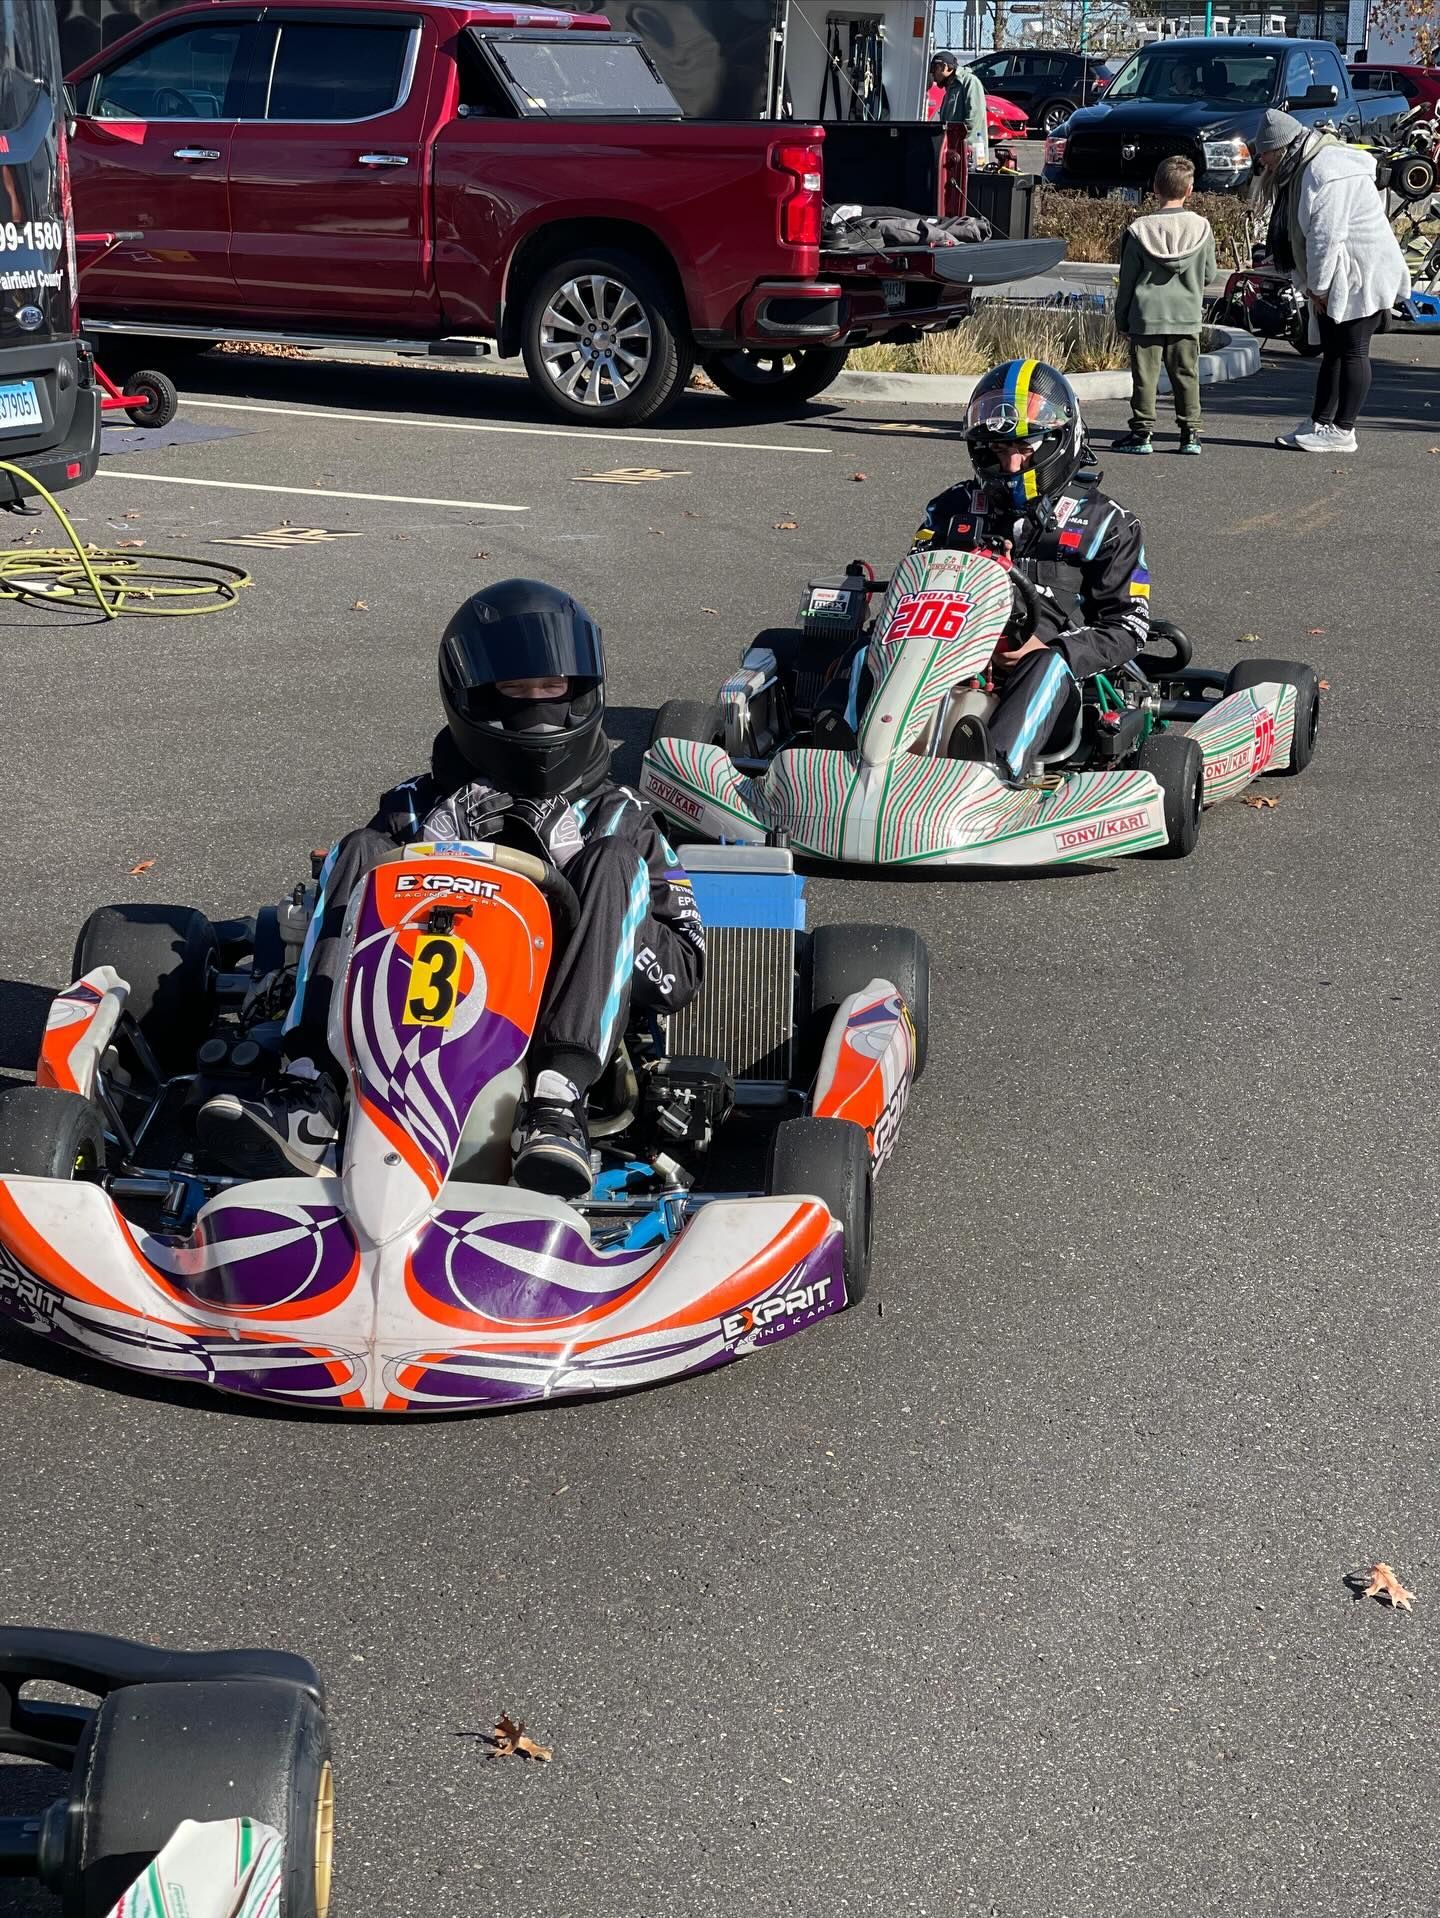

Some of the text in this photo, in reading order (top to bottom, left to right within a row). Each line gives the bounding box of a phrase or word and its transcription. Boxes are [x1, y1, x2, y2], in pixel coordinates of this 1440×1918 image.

[0, 270, 37, 290] airfield
[0, 392, 36, 418] 379051
[917, 592, 966, 602] ROJAS
[884, 601, 972, 643] 206
[1203, 750, 1250, 778] ONY KAR
[648, 774, 704, 818] TONY KART
[1056, 811, 1146, 846] TONY KART
[397, 875, 500, 898] EXPRIT
[456, 894, 497, 906] KART
[409, 939, 458, 1022] 3
[635, 947, 676, 994] EOS
[0, 1268, 62, 1314] PRIT
[723, 1277, 831, 1340] EXPRIT
[725, 1300, 835, 1352] RACING KART
